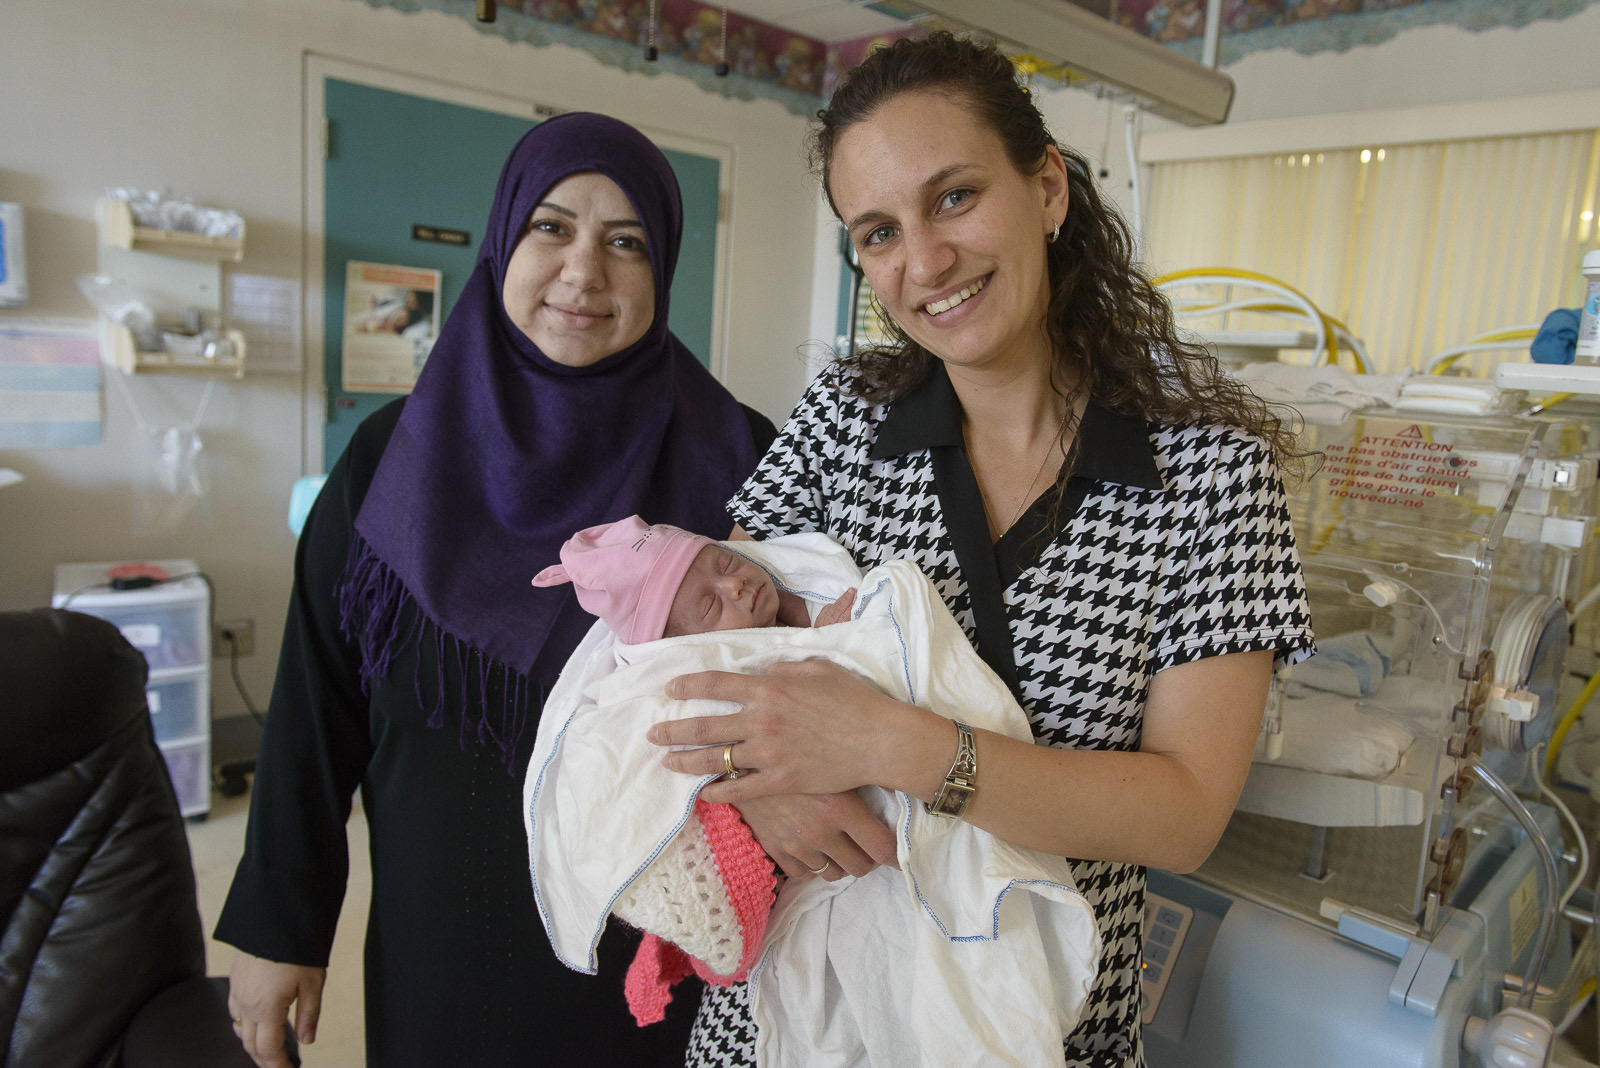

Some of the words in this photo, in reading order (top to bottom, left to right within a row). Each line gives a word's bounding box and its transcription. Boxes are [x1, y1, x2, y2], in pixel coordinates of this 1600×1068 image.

[1359, 436, 1454, 453] ATTENTION
[1326, 444, 1345, 452] ne
[1347, 447, 1376, 455] pas
[1381, 450, 1450, 465] obstruer
[1453, 456, 1478, 467] les
[1321, 464, 1370, 477] risque
[1374, 471, 1394, 480] de
[1377, 460, 1412, 472] d'air
[1329, 477, 1374, 490] grave
[1377, 483, 1417, 496] pour
[1421, 488, 1436, 498] le
[1328, 488, 1424, 509] nouveau-né
